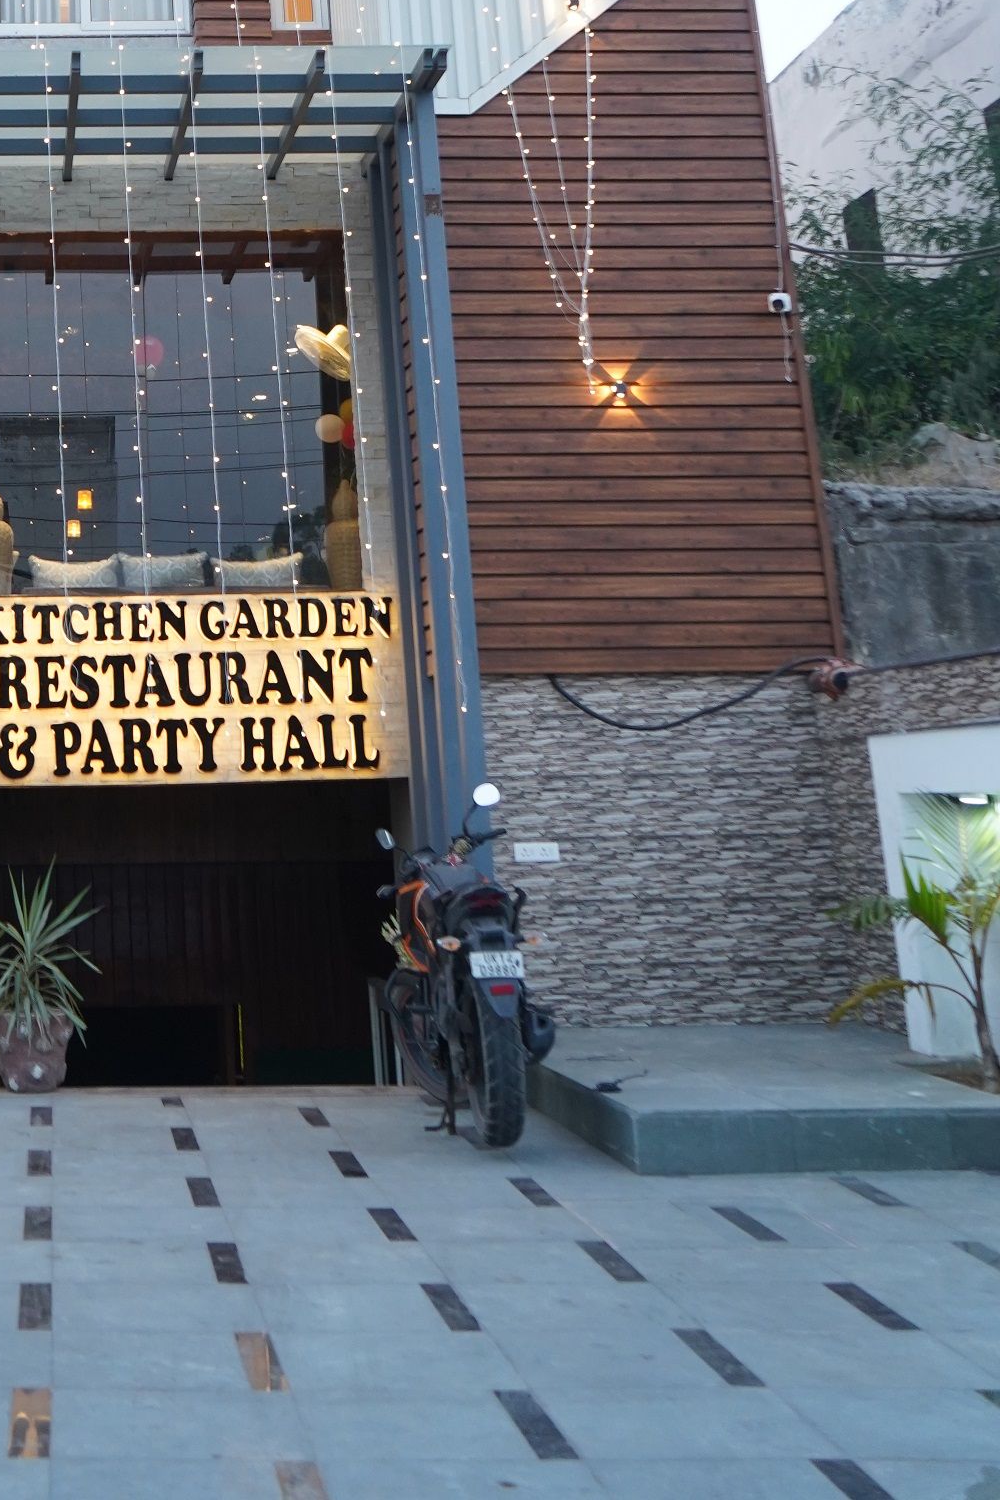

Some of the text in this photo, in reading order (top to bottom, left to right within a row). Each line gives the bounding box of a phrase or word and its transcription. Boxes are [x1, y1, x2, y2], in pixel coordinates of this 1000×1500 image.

[199, 596, 392, 640] GARDEN
[50, 717, 225, 776] PARTY
[239, 714, 380, 771] HALL
